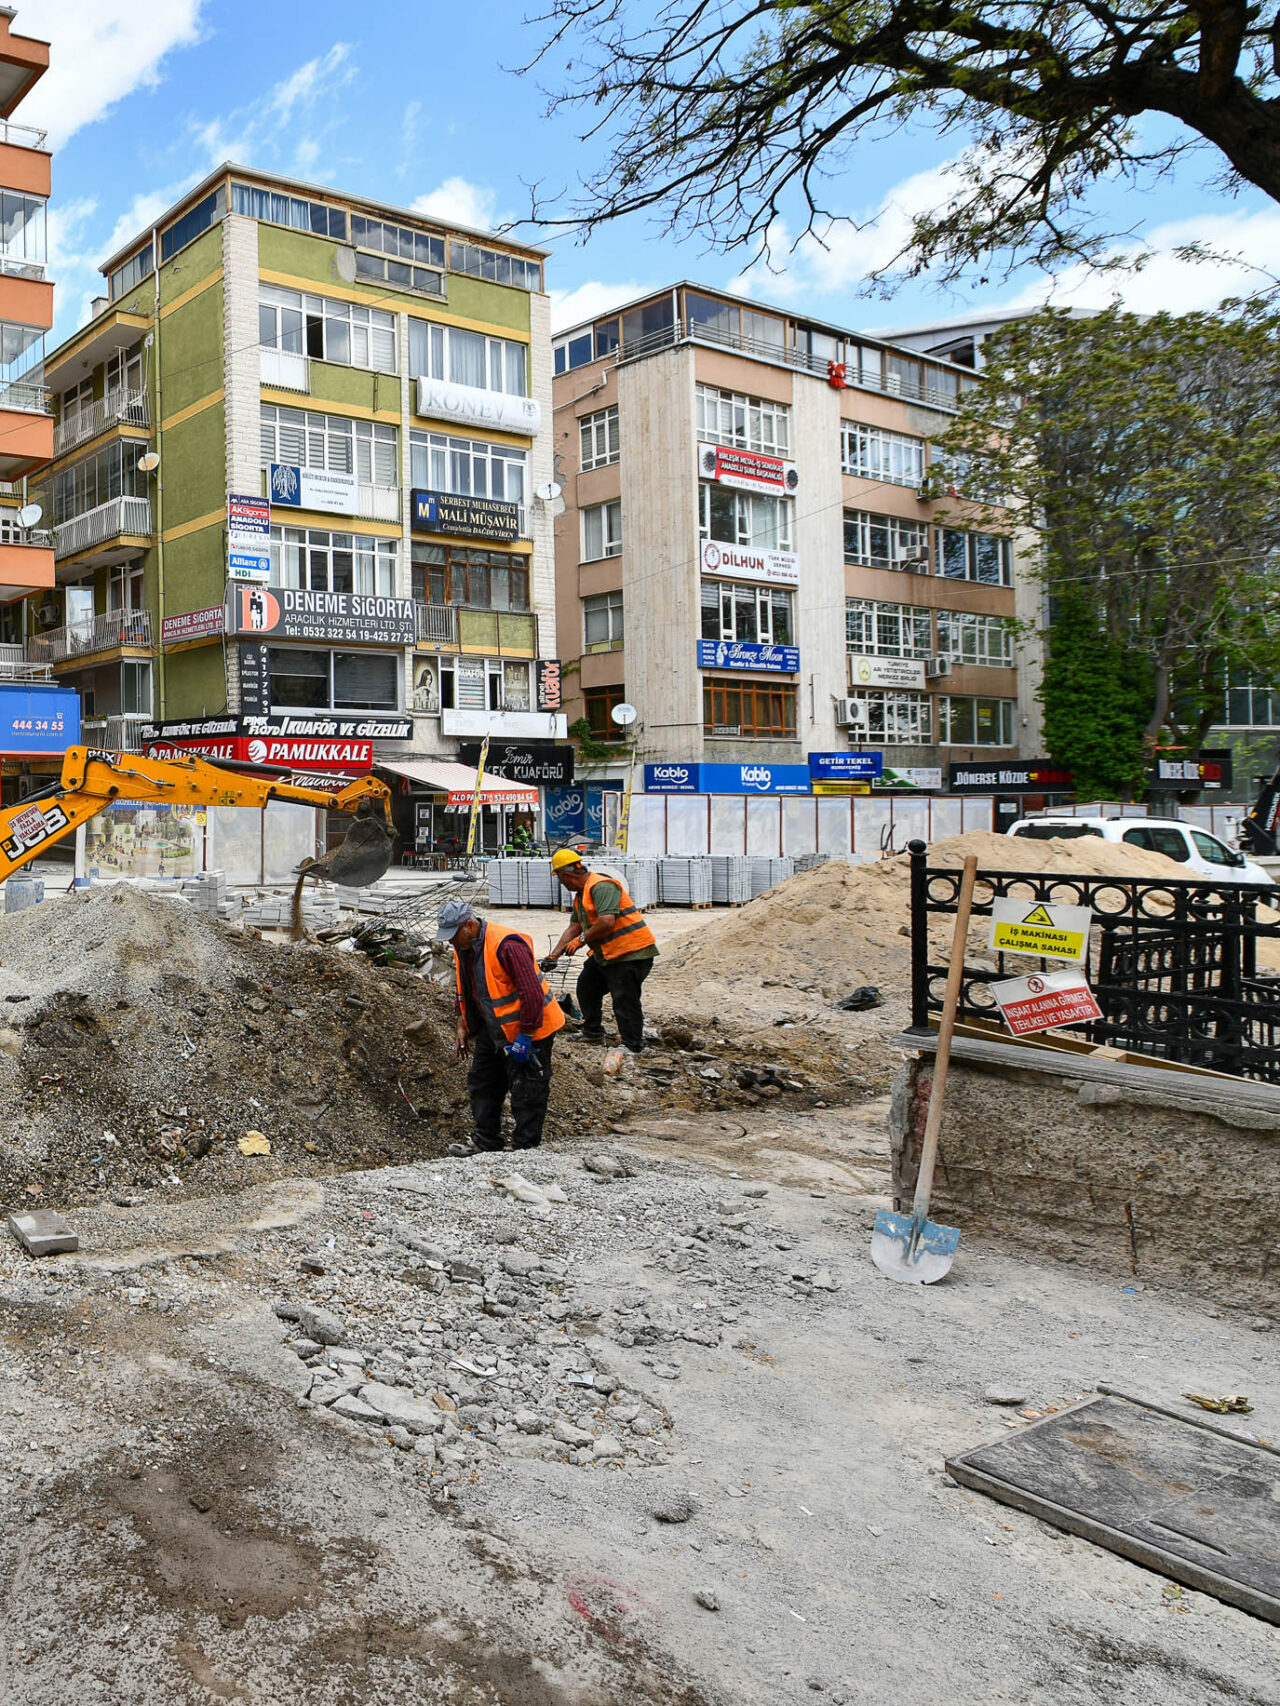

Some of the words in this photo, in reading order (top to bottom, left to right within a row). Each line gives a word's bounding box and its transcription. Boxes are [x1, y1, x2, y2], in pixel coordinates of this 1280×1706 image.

[428, 390, 505, 420] KONEV
[440, 496, 470, 507] SERBEST
[472, 500, 516, 514] MUHASEBECİ
[231, 516, 268, 525] ANADOLU
[231, 522, 264, 532] SİGORTA
[439, 508, 468, 522] MALİ
[470, 512, 517, 530] MÜŞAVİR
[232, 557, 257, 567] Allianz
[722, 551, 764, 570] DİLHUN
[284, 591, 347, 614] DENEME
[164, 616, 191, 630] DENEME
[284, 614, 325, 625] ARACILIK
[380, 620, 397, 629] LTD.
[285, 625, 300, 636] Tel:
[303, 626, 325, 637] 0532
[328, 628, 343, 638] 322
[346, 629, 356, 639] 54
[360, 630, 388, 641] 19-425
[391, 632, 400, 642] 27
[404, 633, 413, 643] 25
[541, 662, 560, 708] kuaför
[12, 720, 32, 729] 444
[35, 720, 48, 730] 34
[51, 721, 64, 730] 55
[192, 724, 202, 735] VE
[202, 719, 238, 734] GÜZELLİK
[243, 716, 269, 726] PINK
[286, 718, 337, 736] KUAFÖR
[339, 723, 356, 736] VE
[356, 720, 411, 737] GÜZELLİK
[248, 725, 280, 735] FLOYD
[269, 743, 370, 761] PAMUKKALE
[502, 746, 533, 764] Emir
[819, 756, 845, 765] GETİR
[514, 762, 563, 779] KUAFÖRÜ
[654, 766, 688, 778] Kablo
[741, 766, 771, 781] Kablo
[953, 772, 997, 785] DÖNERSE
[999, 770, 1029, 784] KÖZDE
[547, 792, 580, 820] Kablo
[1010, 927, 1018, 936] İŞ
[1021, 929, 1068, 941] MAKİNASI
[999, 938, 1038, 949] ÇALIŞMA
[1041, 944, 1077, 955] SAHASI
[1004, 1004, 1031, 1019] İNŞAAT
[1032, 997, 1059, 1013] ALANINA
[1058, 991, 1090, 1006] GİRMEK
[1014, 1016, 1047, 1031] TEHLİKELİ
[1048, 1013, 1059, 1022] VE
[1056, 1005, 1095, 1020] YASAKTIR
